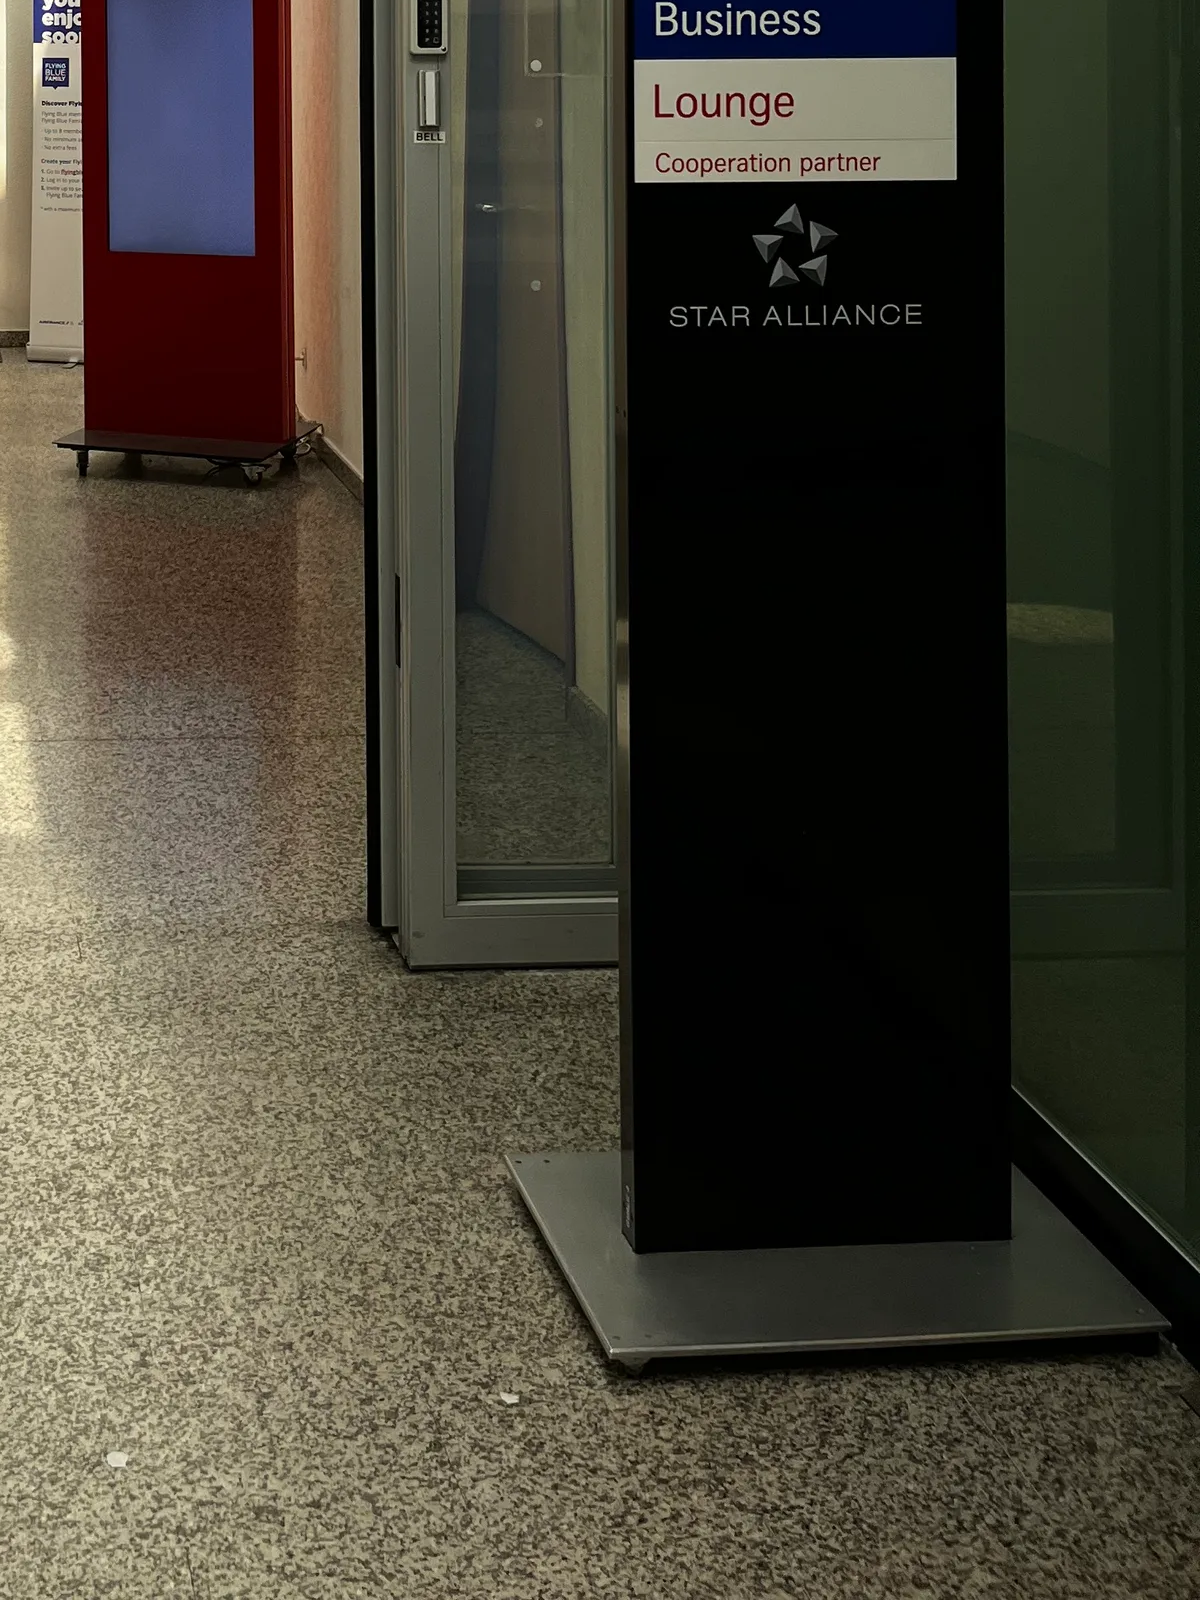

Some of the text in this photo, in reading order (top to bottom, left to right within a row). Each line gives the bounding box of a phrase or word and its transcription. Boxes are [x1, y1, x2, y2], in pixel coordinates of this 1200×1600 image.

[655, 1, 821, 36] Business
[41, 31, 82, 44] soo
[654, 84, 795, 126] Lounge
[416, 132, 443, 142] BELL
[655, 152, 881, 177] Cooperation partner
[669, 303, 923, 328] STAR ALLIANCE
